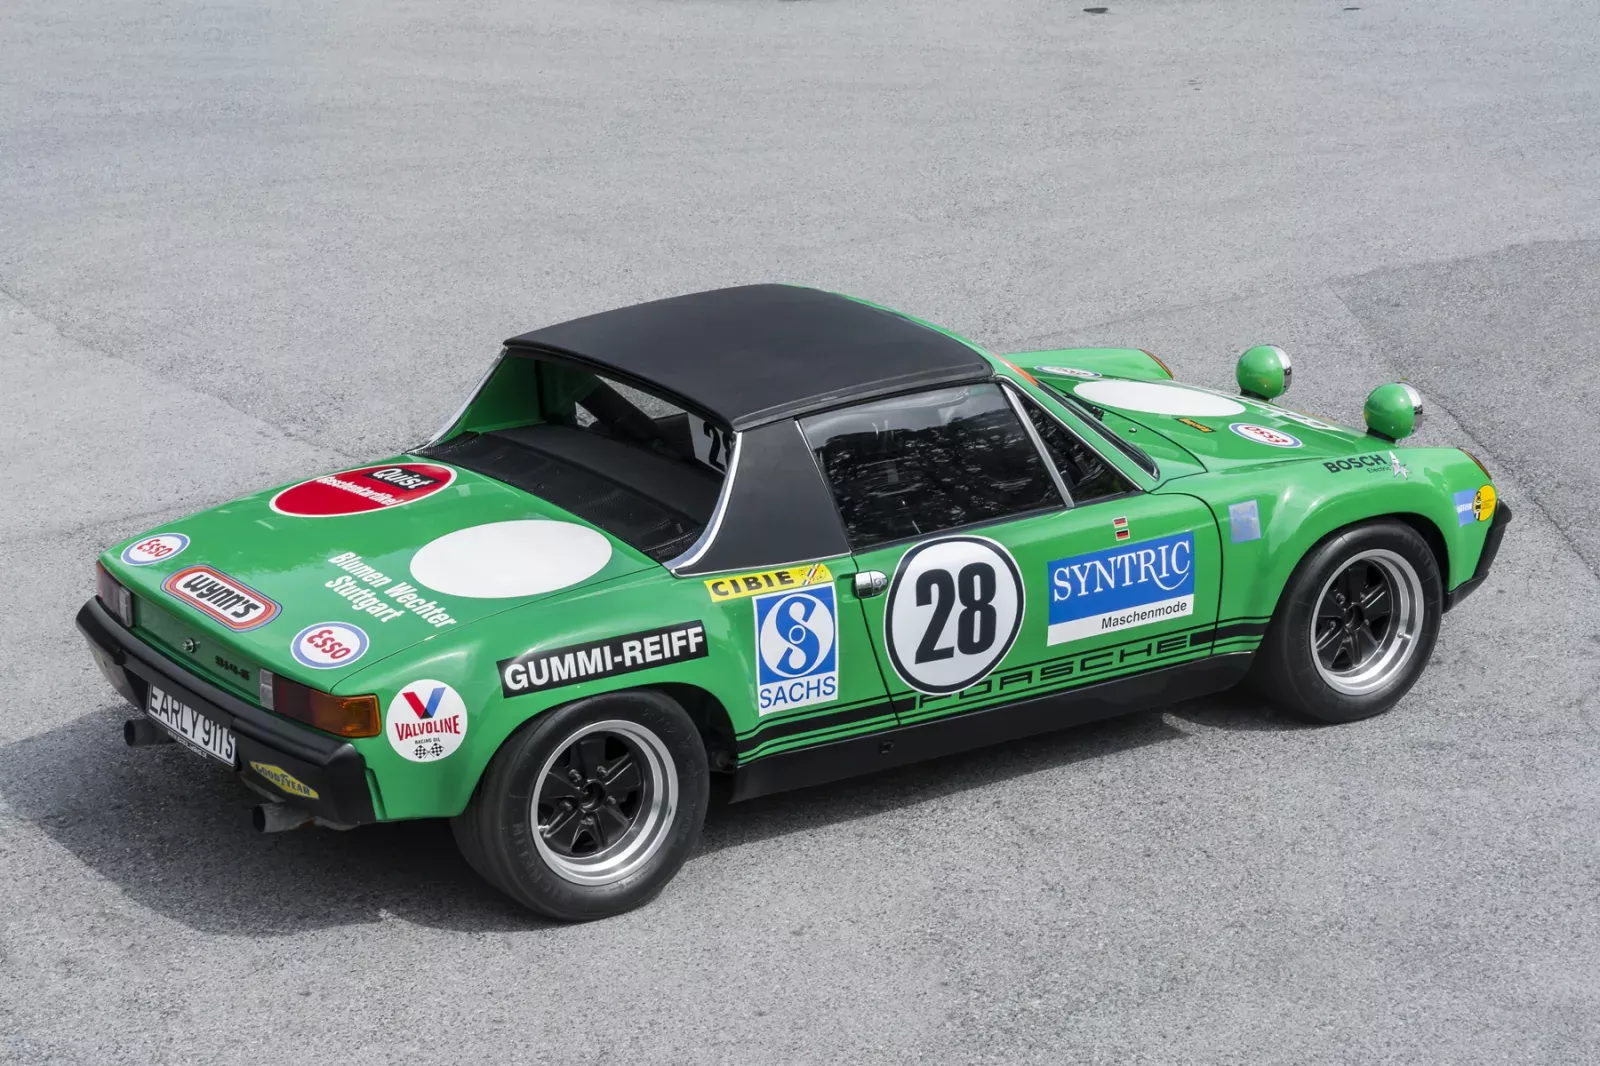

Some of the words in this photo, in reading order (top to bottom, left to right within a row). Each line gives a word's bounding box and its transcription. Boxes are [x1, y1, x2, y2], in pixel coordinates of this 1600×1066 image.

[372, 468, 435, 489] Quist
[1322, 454, 1387, 473] BOSCH
[137, 538, 173, 557] Esso
[1053, 540, 1191, 602] SYNTRIC
[325, 575, 405, 623] Stuttgart
[328, 551, 392, 588] Blumen
[383, 581, 457, 628] Wechter
[915, 562, 997, 664] 28
[1101, 601, 1187, 629] Maschenmode
[306, 629, 351, 660] Esso
[504, 626, 704, 691] GUMMI-REIFF
[760, 676, 836, 709] SACHS
[394, 714, 461, 741] VALVOLINE
